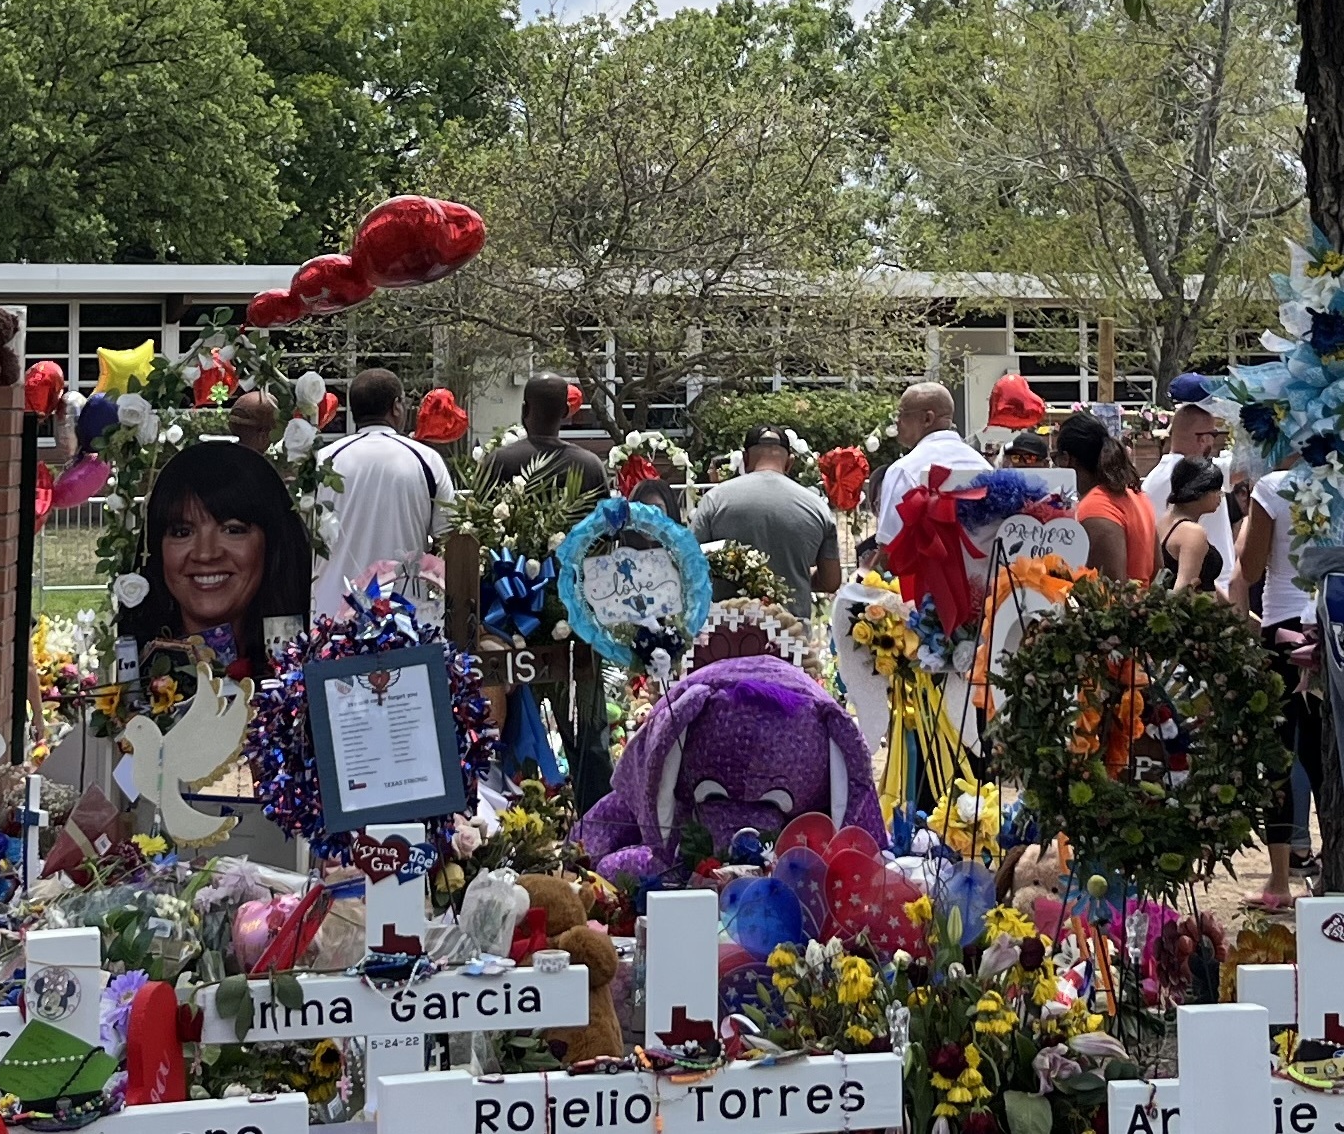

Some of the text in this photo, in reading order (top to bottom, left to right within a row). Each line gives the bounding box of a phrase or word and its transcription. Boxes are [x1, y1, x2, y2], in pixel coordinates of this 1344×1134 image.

[1005, 523, 1075, 545] PRAYERS
[591, 572, 678, 601] love
[507, 651, 536, 684] IS
[391, 982, 542, 1024] Garcia
[371, 1036, 420, 1050] 5-24-22
[688, 1080, 865, 1123] Torres
